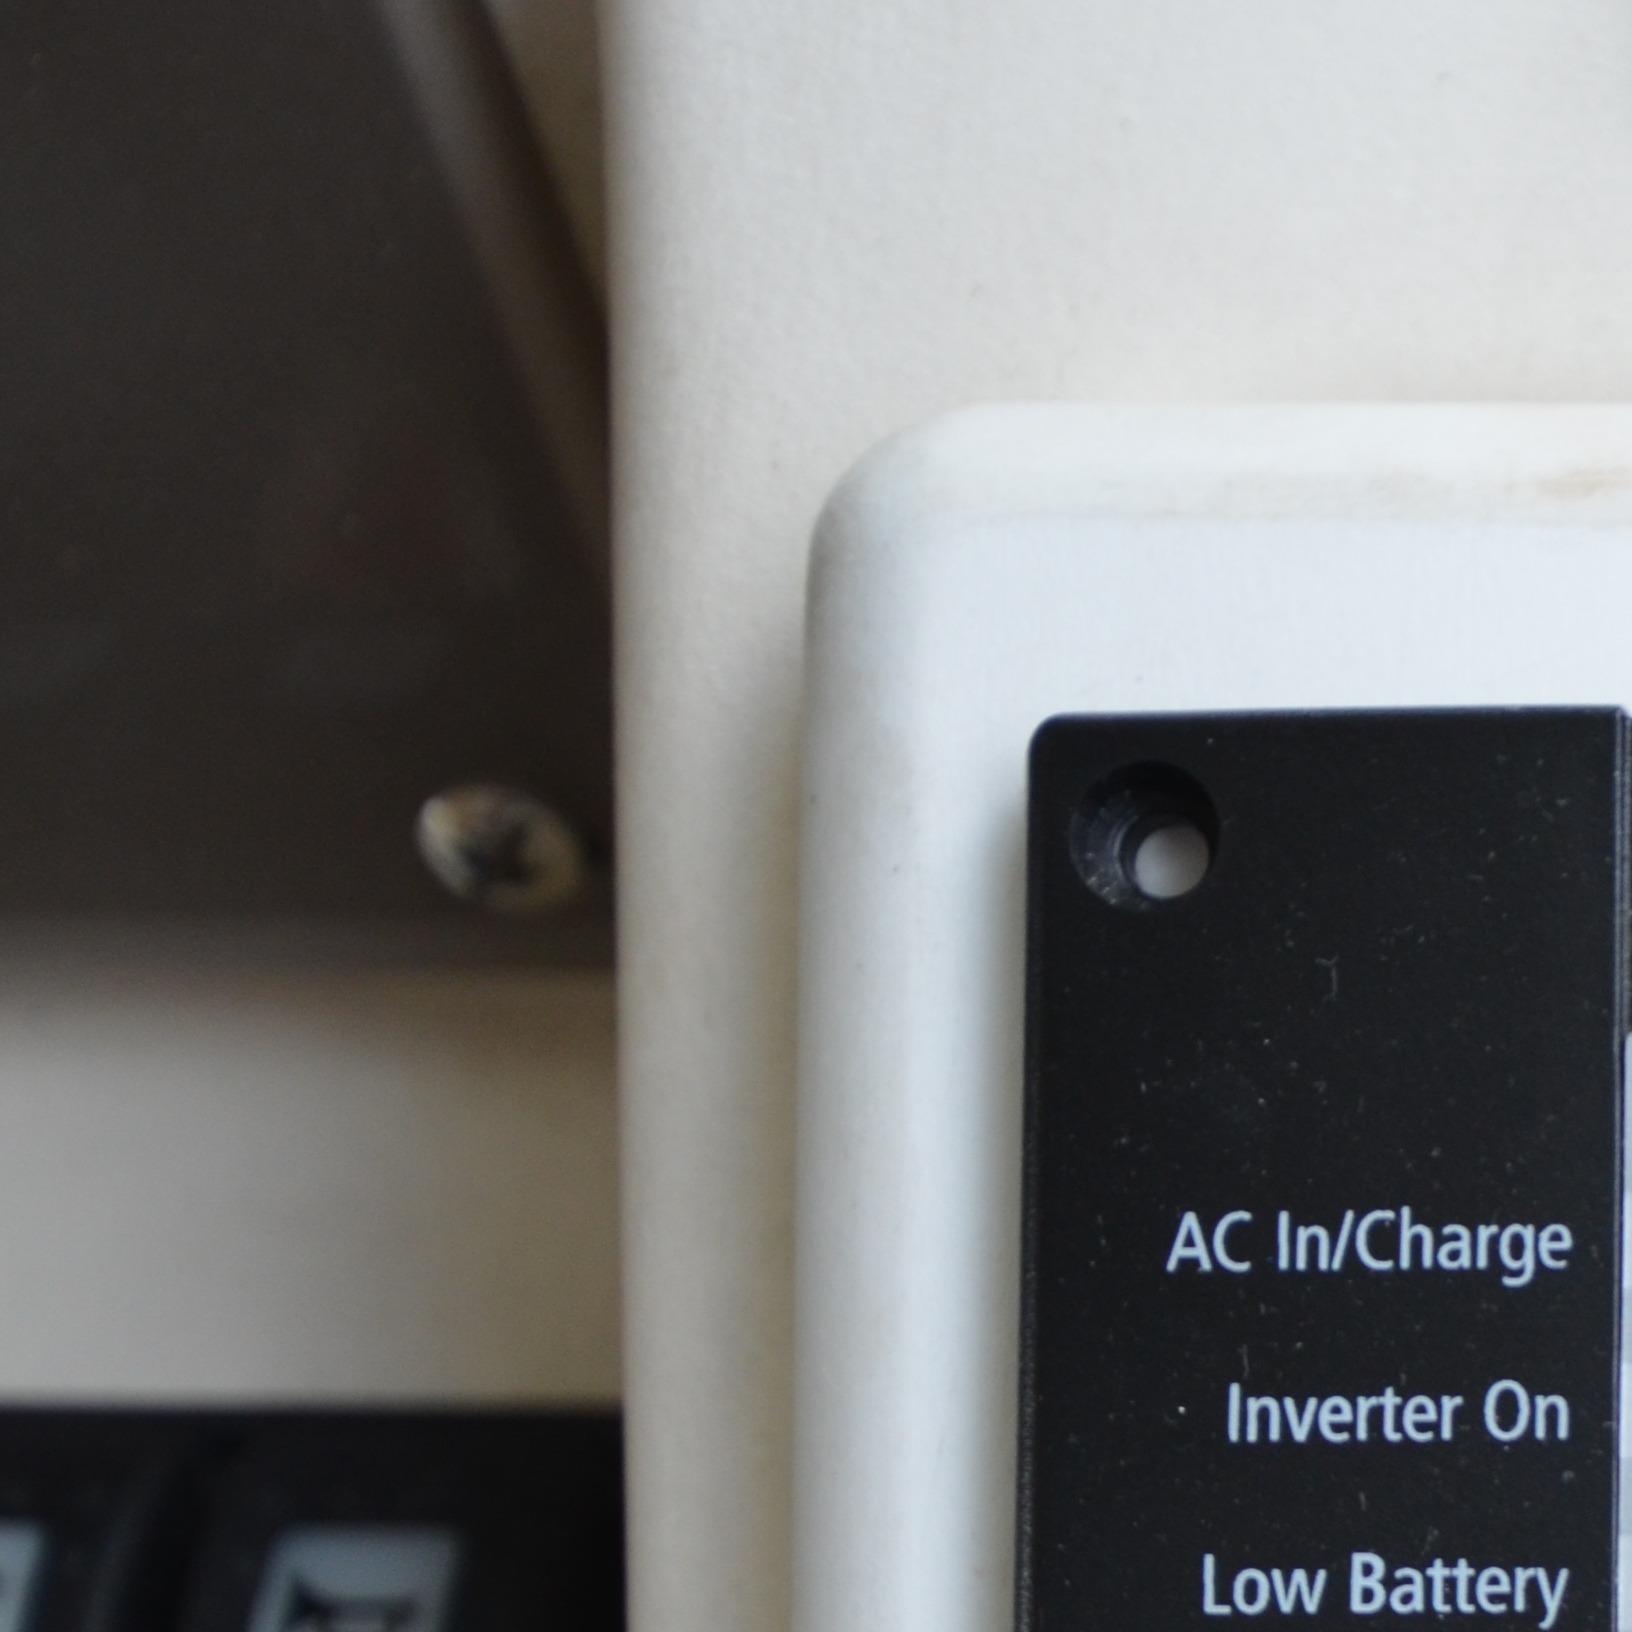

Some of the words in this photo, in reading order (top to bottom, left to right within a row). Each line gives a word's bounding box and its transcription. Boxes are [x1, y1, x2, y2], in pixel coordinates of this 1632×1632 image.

[1165, 1209, 1253, 1273] AC
[1277, 1205, 1574, 1288] In/Charge
[1227, 1381, 1464, 1444] Inverter
[1483, 1379, 1571, 1442] On
[1202, 1552, 1328, 1616] Low
[1349, 1551, 1570, 1630] Battery
